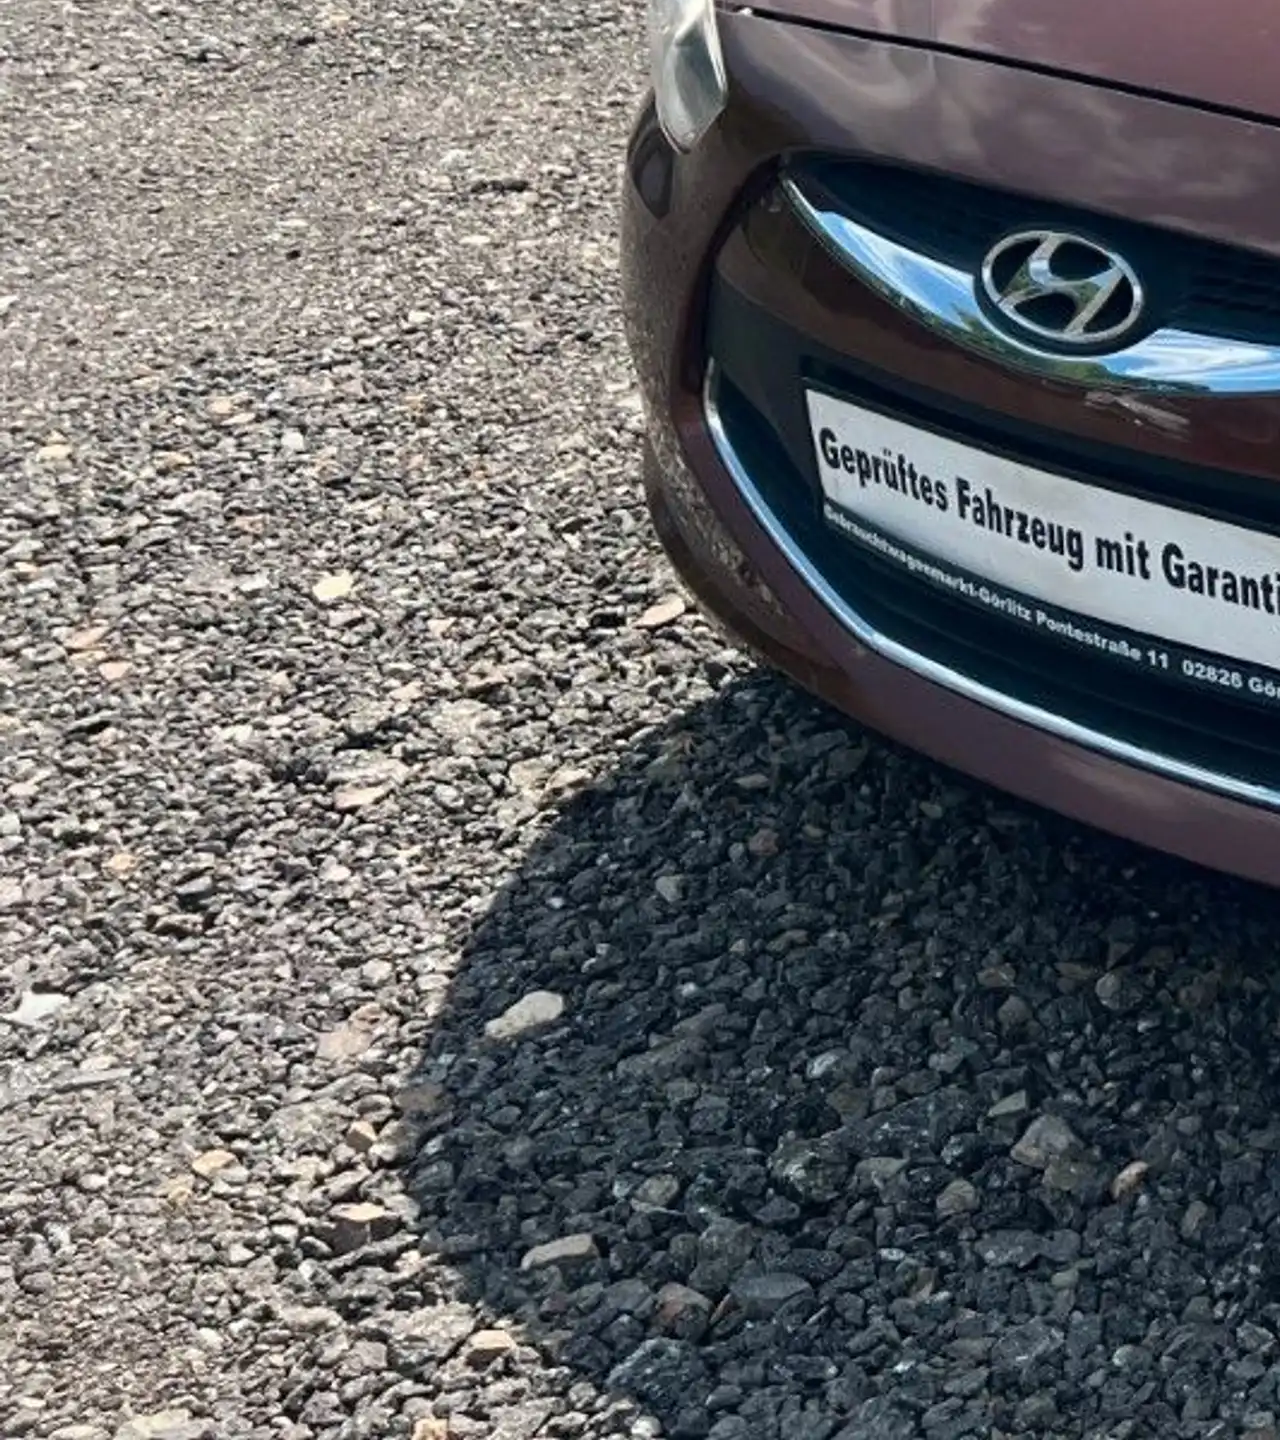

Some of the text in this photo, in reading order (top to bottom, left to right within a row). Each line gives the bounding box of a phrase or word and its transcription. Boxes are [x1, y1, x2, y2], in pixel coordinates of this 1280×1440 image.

[819, 427, 949, 511] Geprüftes
[955, 477, 1084, 571] Fahrzeug
[1096, 532, 1150, 580] mit
[1036, 609, 1142, 661] Pontestraße
[1147, 650, 1169, 669] 11
